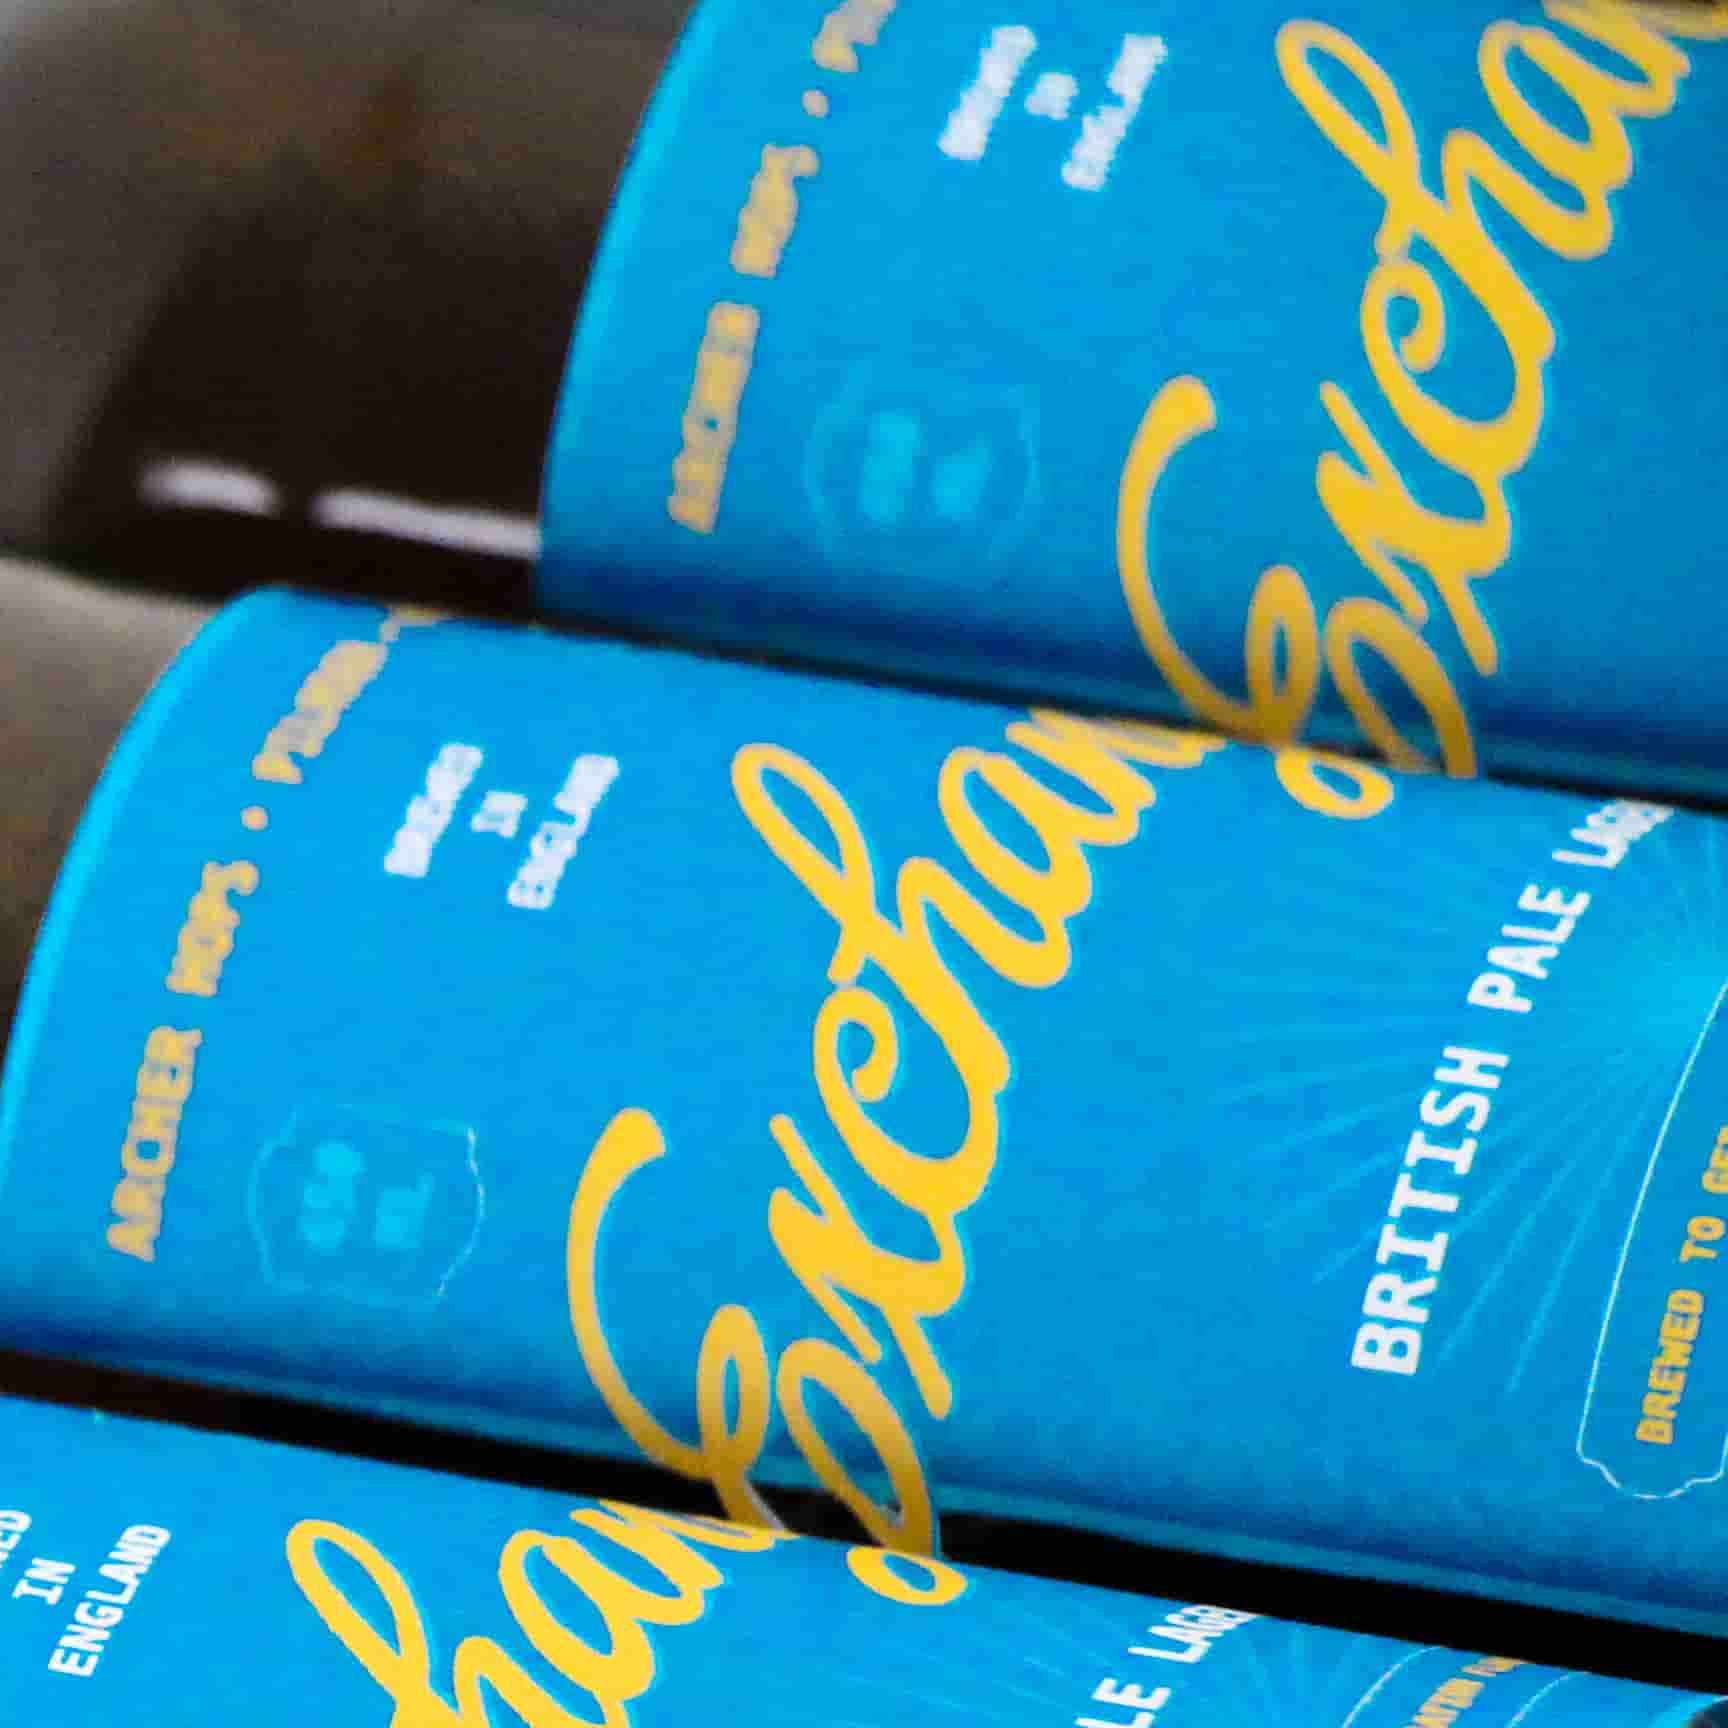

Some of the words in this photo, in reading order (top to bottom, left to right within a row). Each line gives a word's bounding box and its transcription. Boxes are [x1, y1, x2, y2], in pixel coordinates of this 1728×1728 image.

[1352, 1046, 1509, 1375] BRITISH
[1467, 884, 1590, 1013] PALE
[1635, 1289, 1703, 1445] BREWED
[1680, 1215, 1726, 1262] TO
[13, 1557, 76, 1605] IN
[48, 1524, 171, 1677] ENGLAND
